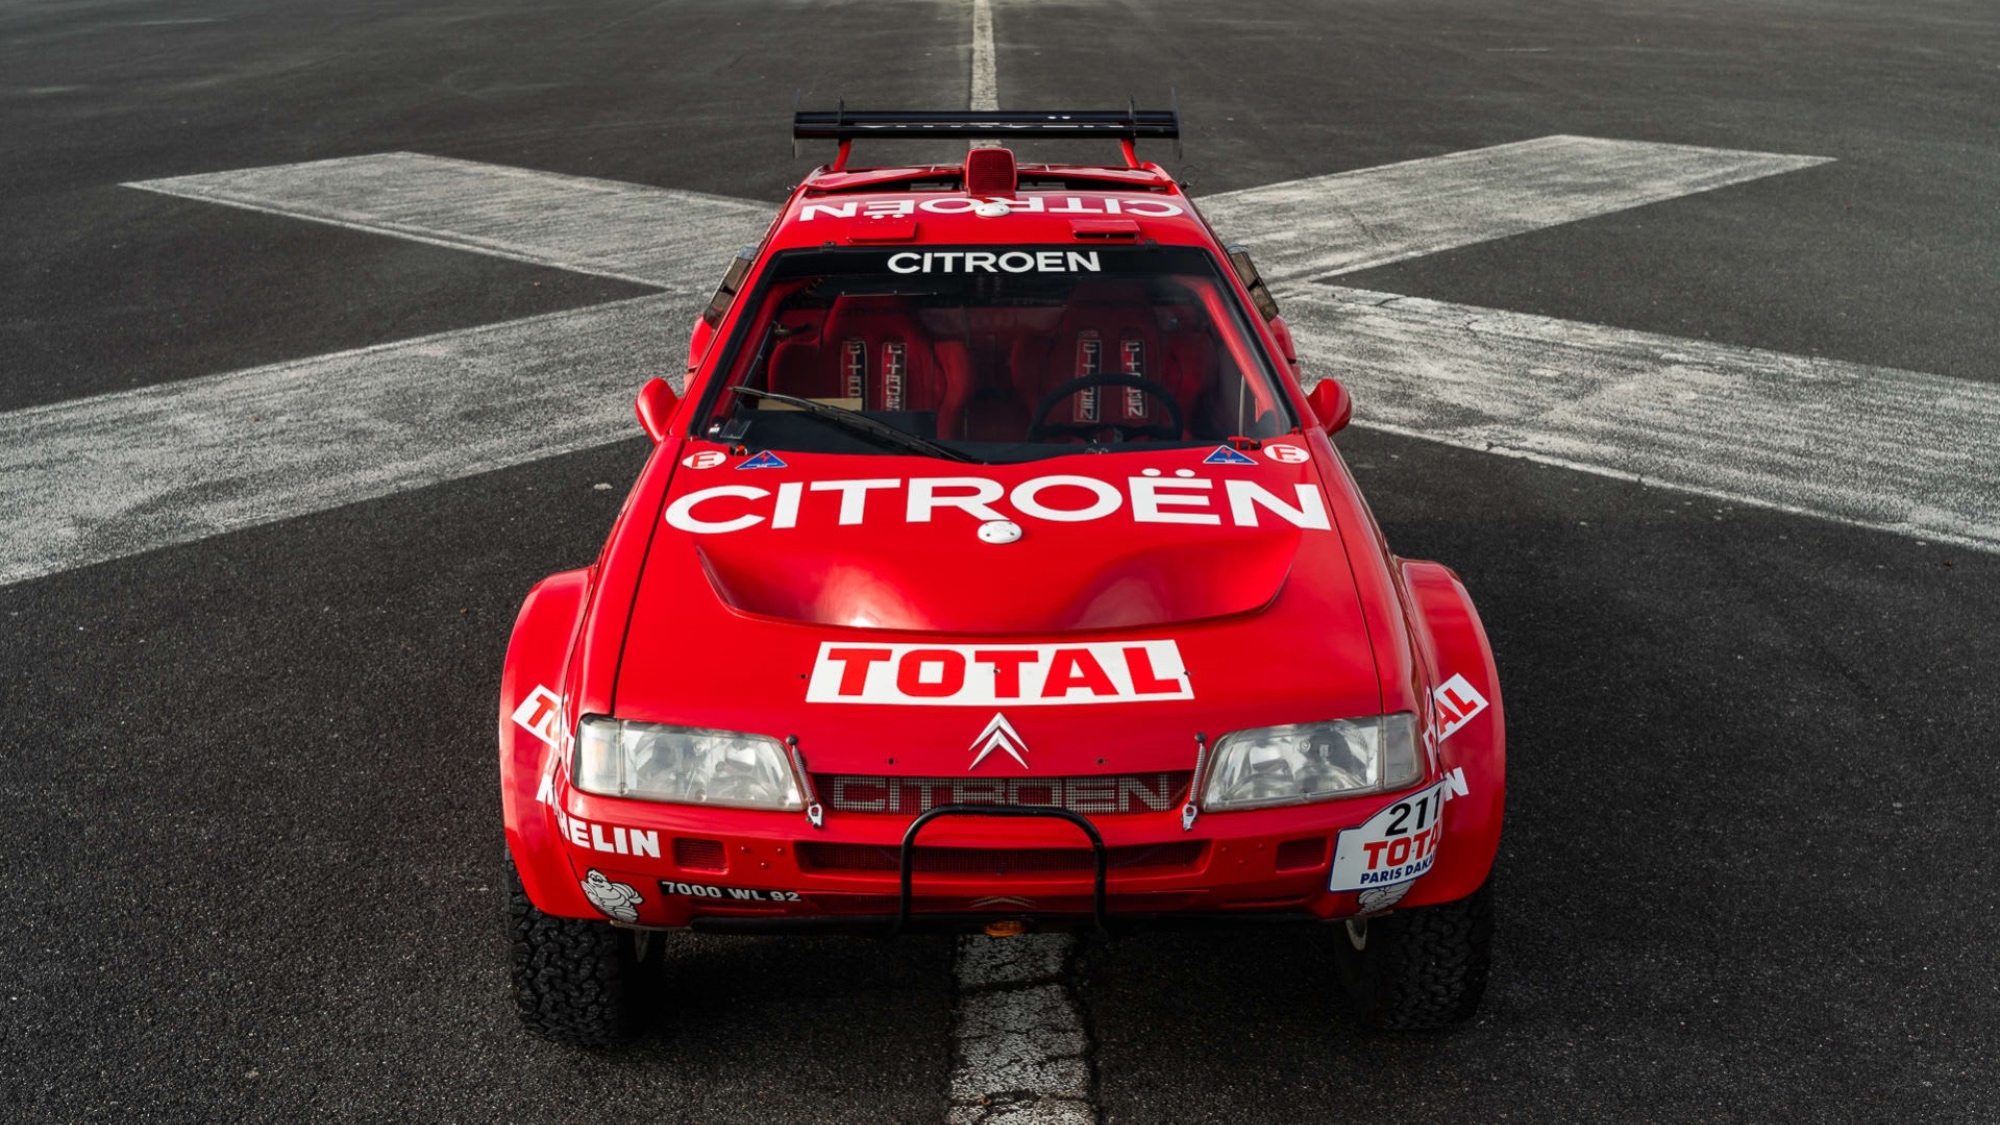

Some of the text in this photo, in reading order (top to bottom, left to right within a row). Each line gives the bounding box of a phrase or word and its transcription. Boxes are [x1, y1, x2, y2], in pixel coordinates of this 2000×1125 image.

[887, 251, 1101, 273] CITROEN
[847, 344, 862, 396] CITRO
[886, 344, 902, 411] CITROË
[665, 468, 1331, 533] CITROËN
[827, 647, 1182, 698] TOTAL
[834, 775, 1168, 811] CITROEN
[1385, 787, 1441, 836] 211
[1360, 853, 1433, 884] PARIS DAKA
[1363, 821, 1439, 870] TOTA
[662, 881, 802, 902] 7000 WL 92
